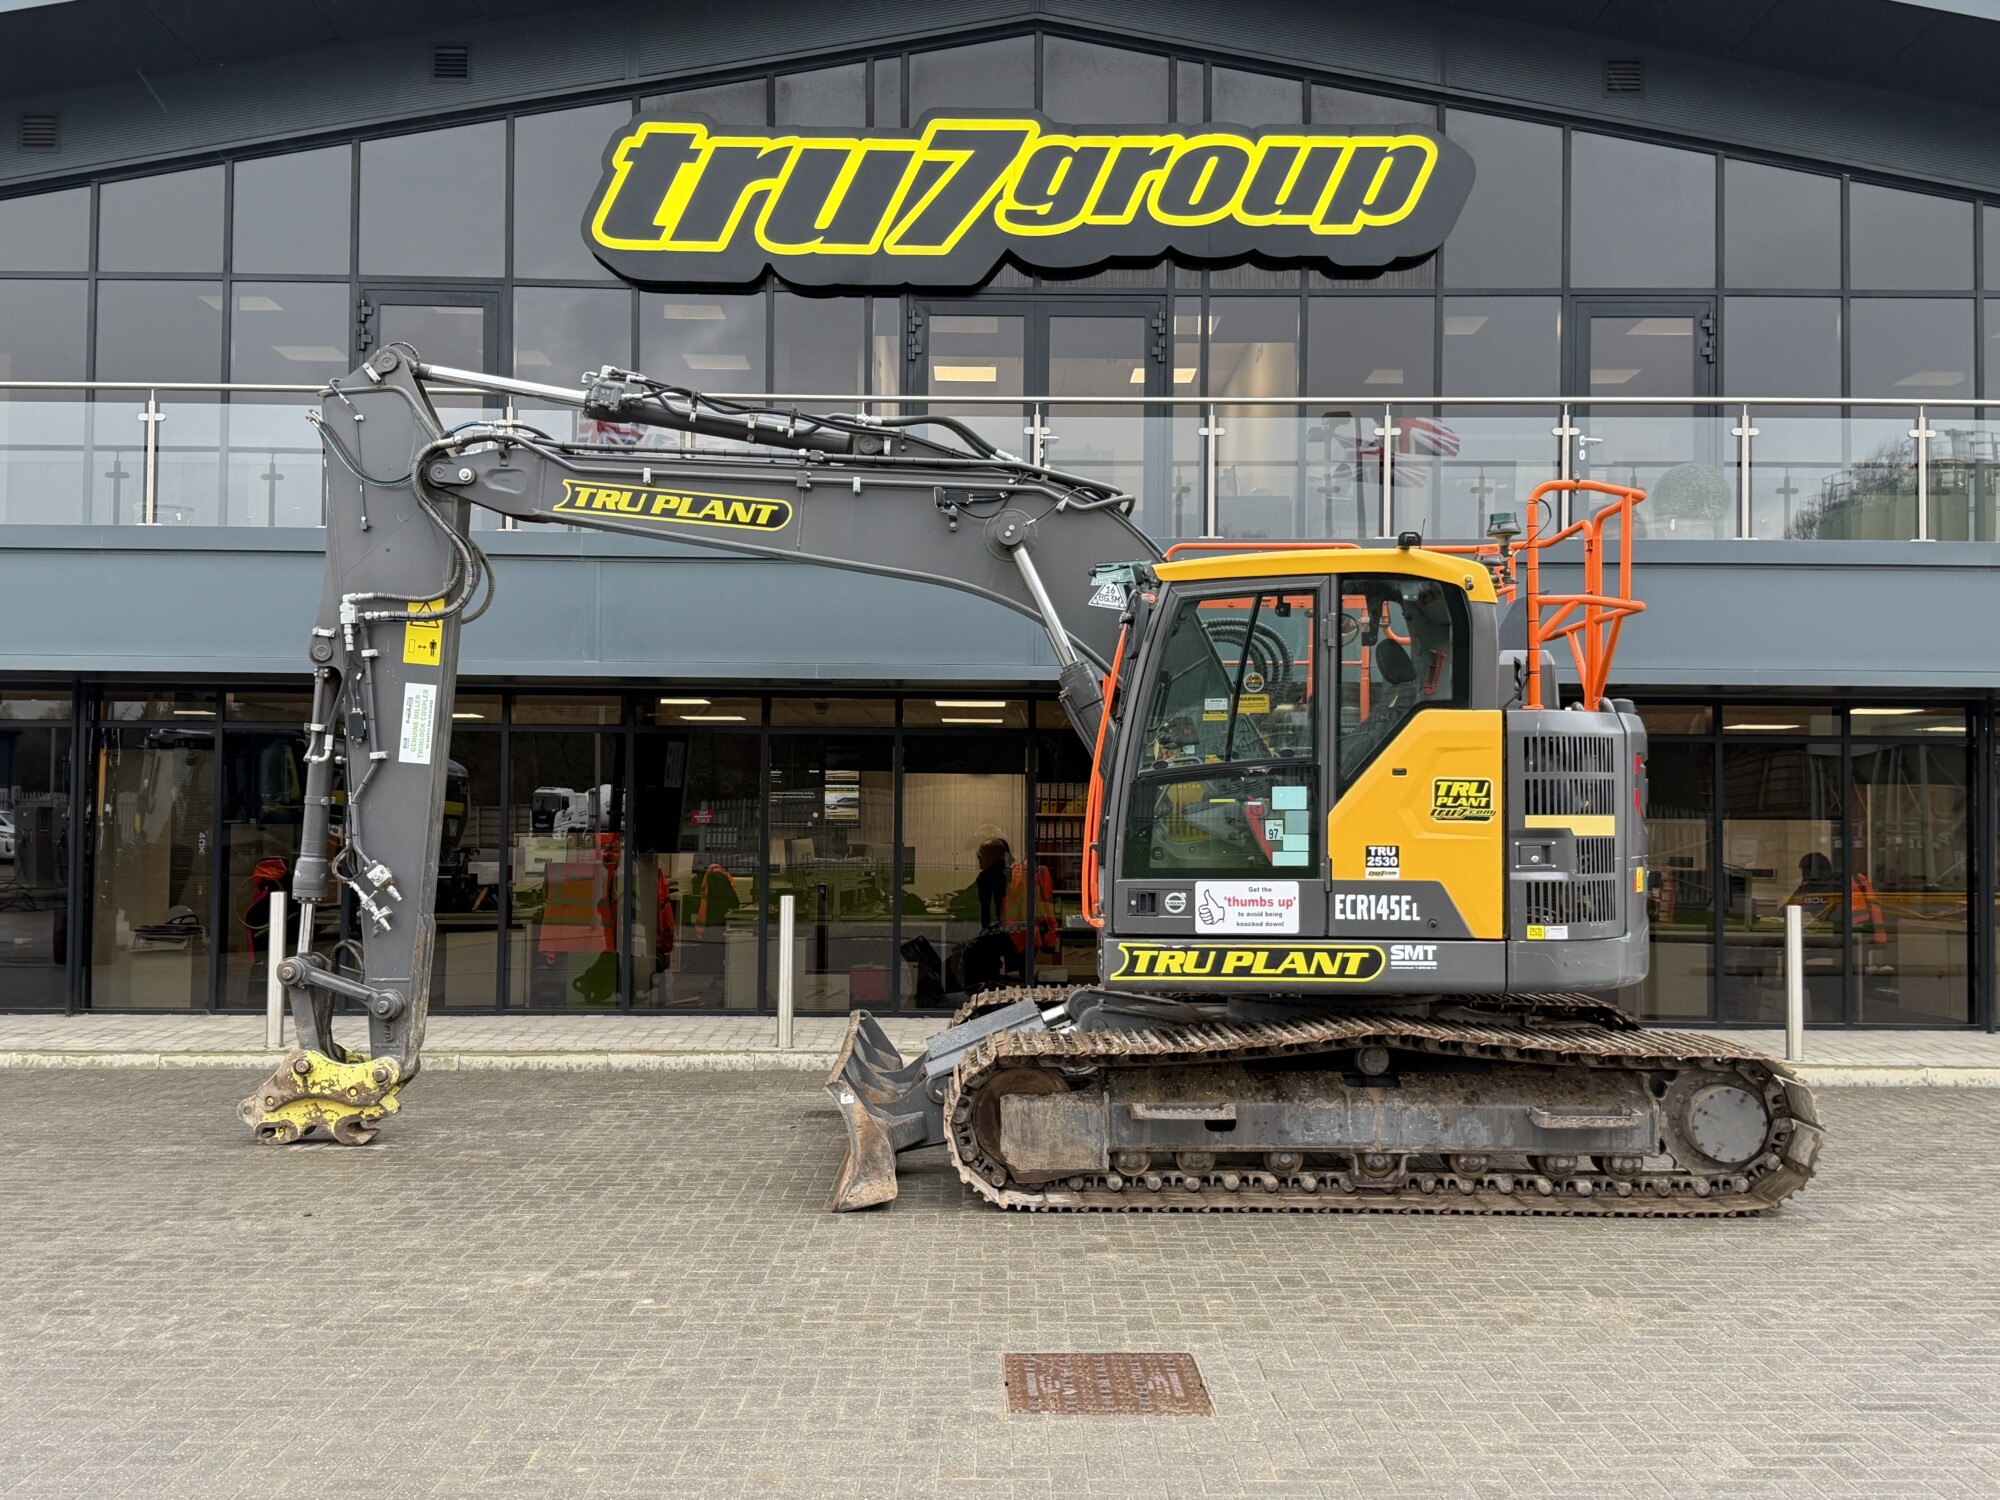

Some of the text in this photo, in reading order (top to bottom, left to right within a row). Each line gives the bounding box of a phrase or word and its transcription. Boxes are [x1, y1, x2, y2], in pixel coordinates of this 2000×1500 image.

[574, 487, 779, 525] TRU PLANT
[1105, 585, 1116, 595] 16
[417, 689, 429, 758] TWINLOCK COUPLER
[411, 721, 419, 752] GENUINE
[1436, 781, 1489, 796] TRU
[1436, 797, 1489, 807] PLANT
[1268, 828, 1279, 840] 97
[1368, 846, 1396, 856] TRU
[1366, 856, 1398, 867] 2530
[1264, 911, 1283, 919] being
[1390, 944, 1437, 960] SMT
[1132, 950, 1369, 975] TRU PLANT
